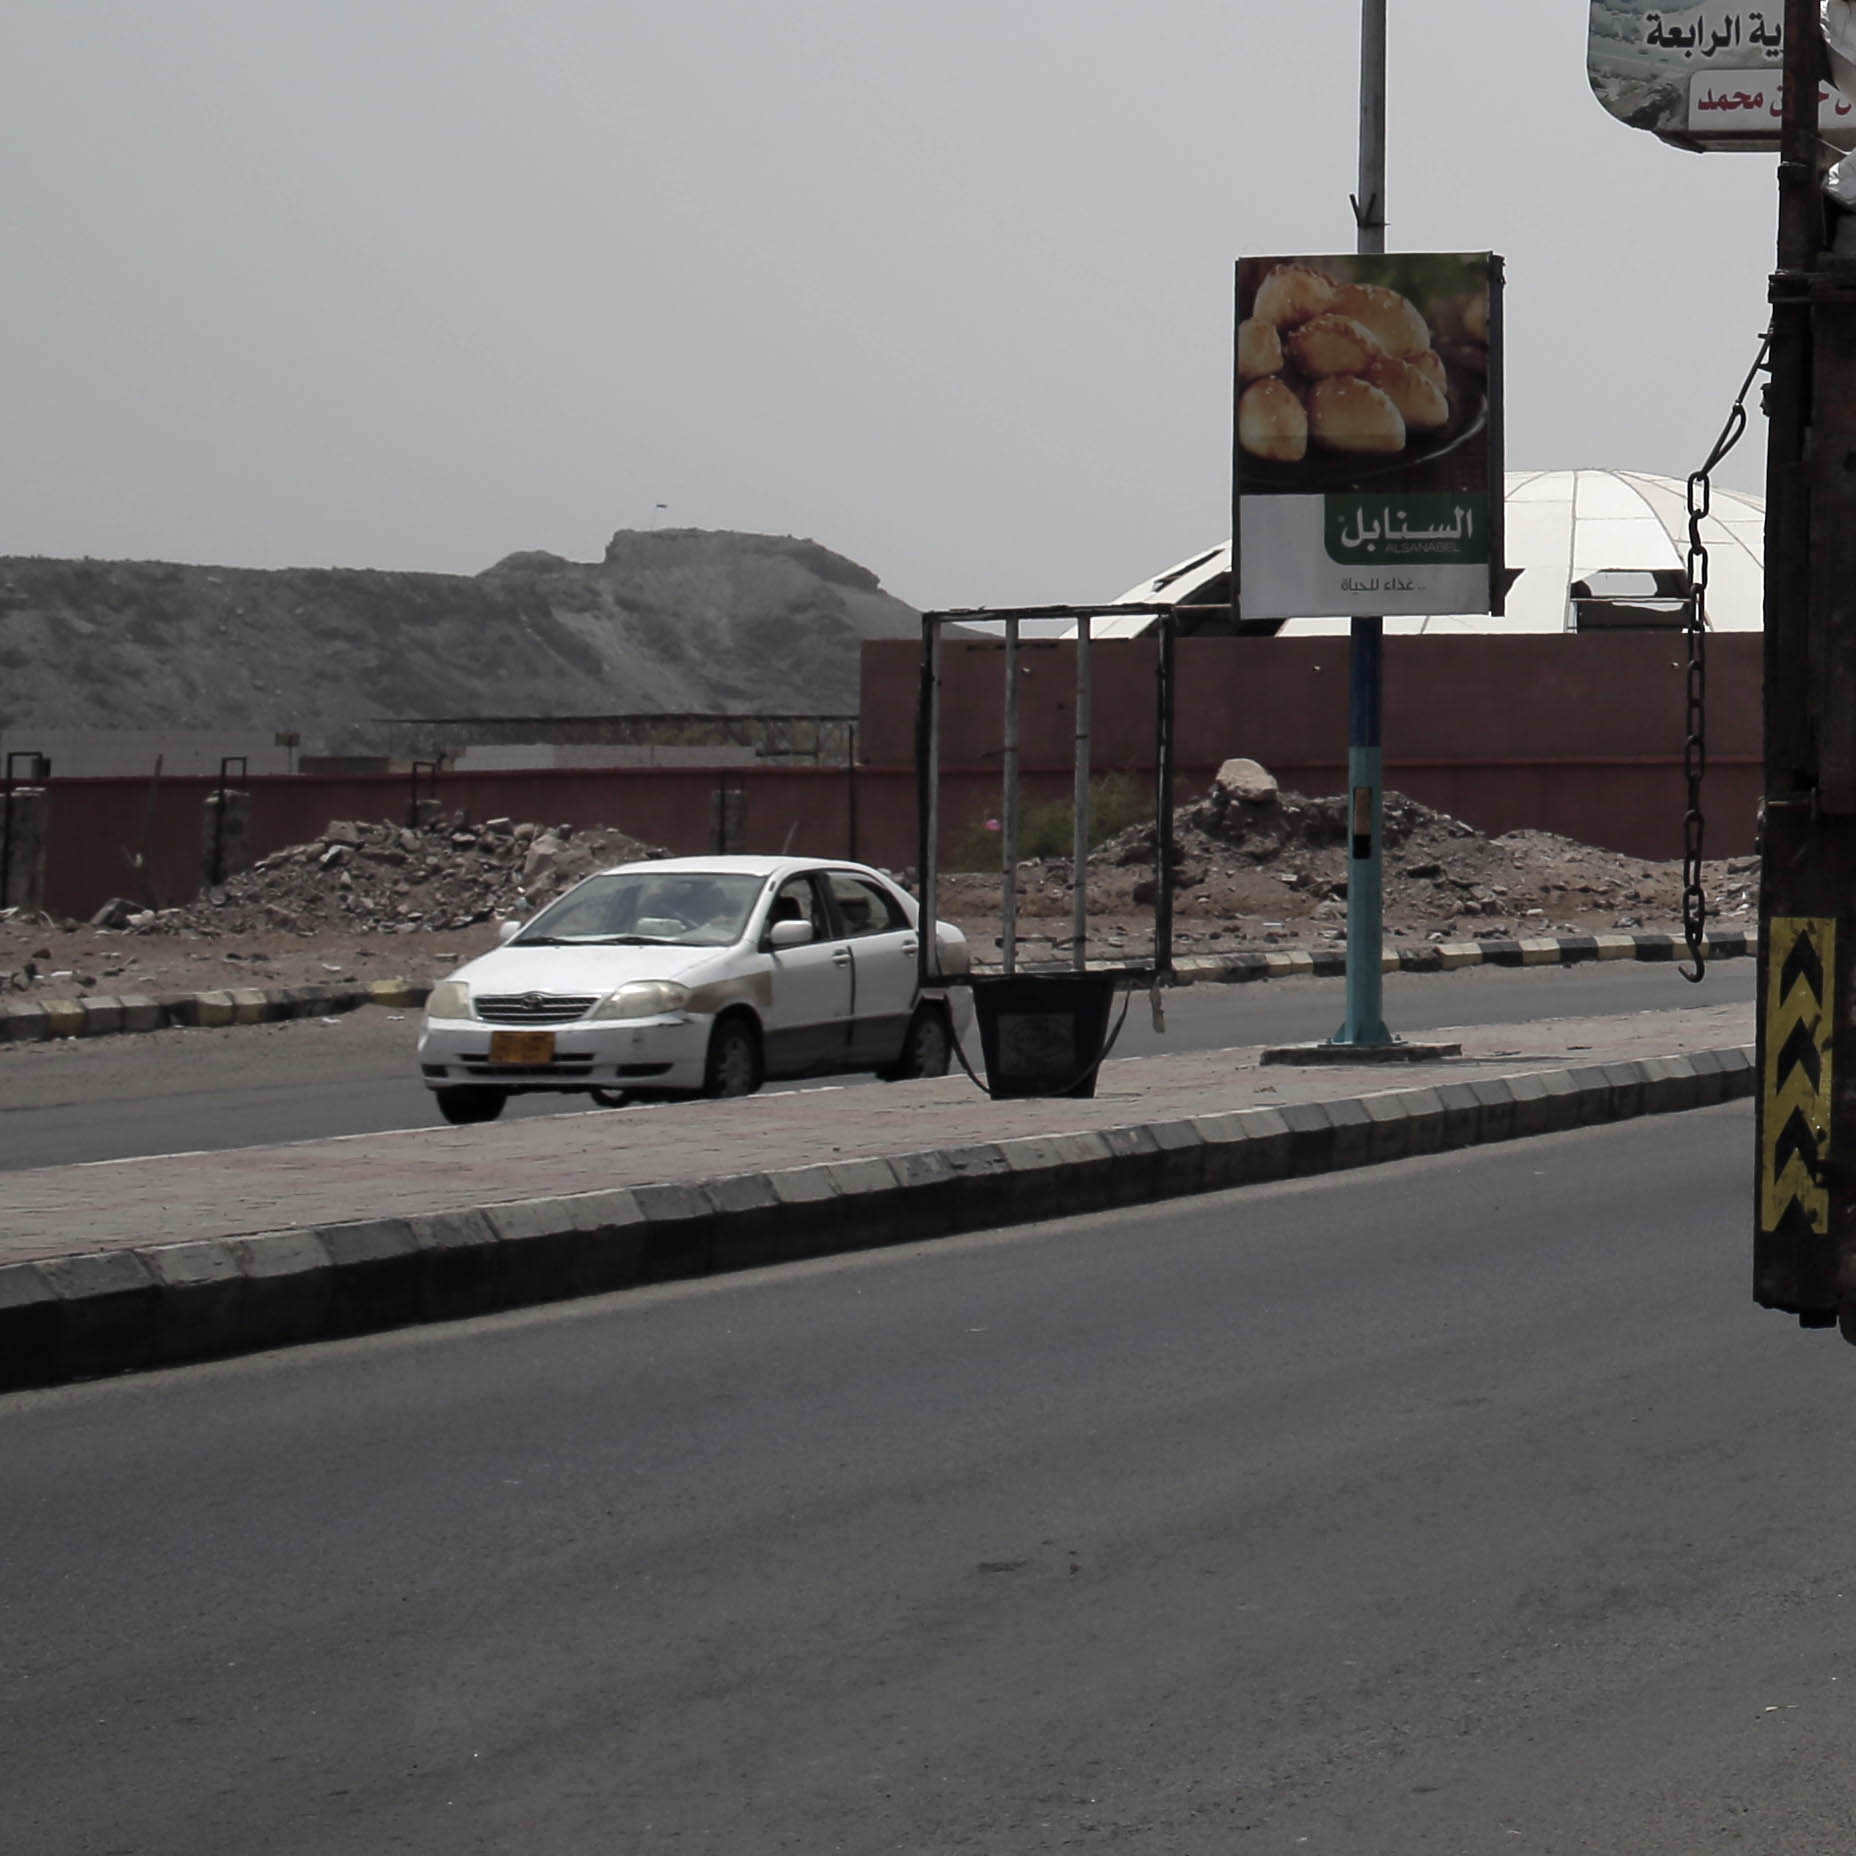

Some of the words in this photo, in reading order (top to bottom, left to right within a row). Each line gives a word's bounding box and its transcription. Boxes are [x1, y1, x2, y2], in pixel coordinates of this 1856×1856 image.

[1645, 14, 1741, 58] الرابعة
[1697, 87, 1765, 112] محمد
[1340, 504, 1473, 553] السنابل
